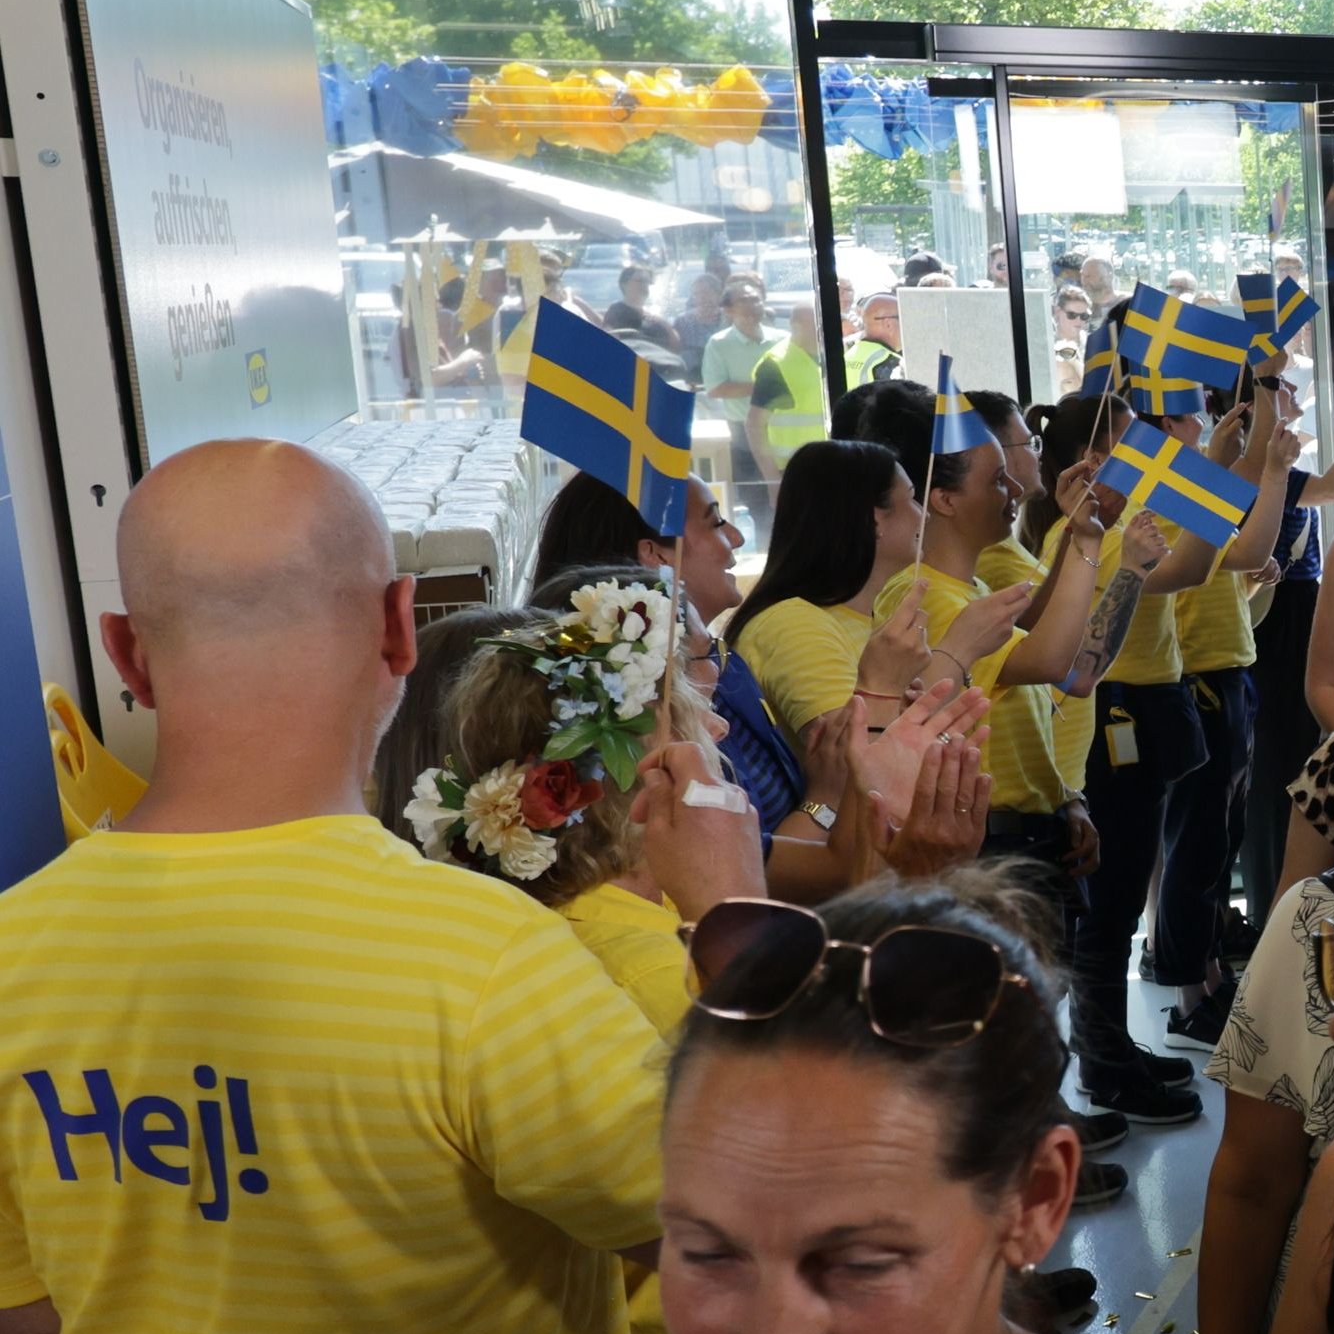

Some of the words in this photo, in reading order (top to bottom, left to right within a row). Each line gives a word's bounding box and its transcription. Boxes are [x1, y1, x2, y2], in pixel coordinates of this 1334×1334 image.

[133, 57, 233, 160] Organisieren,
[151, 172, 238, 256] auffrischen,
[167, 282, 236, 382] genießen
[22, 1064, 270, 1223] Hej!
